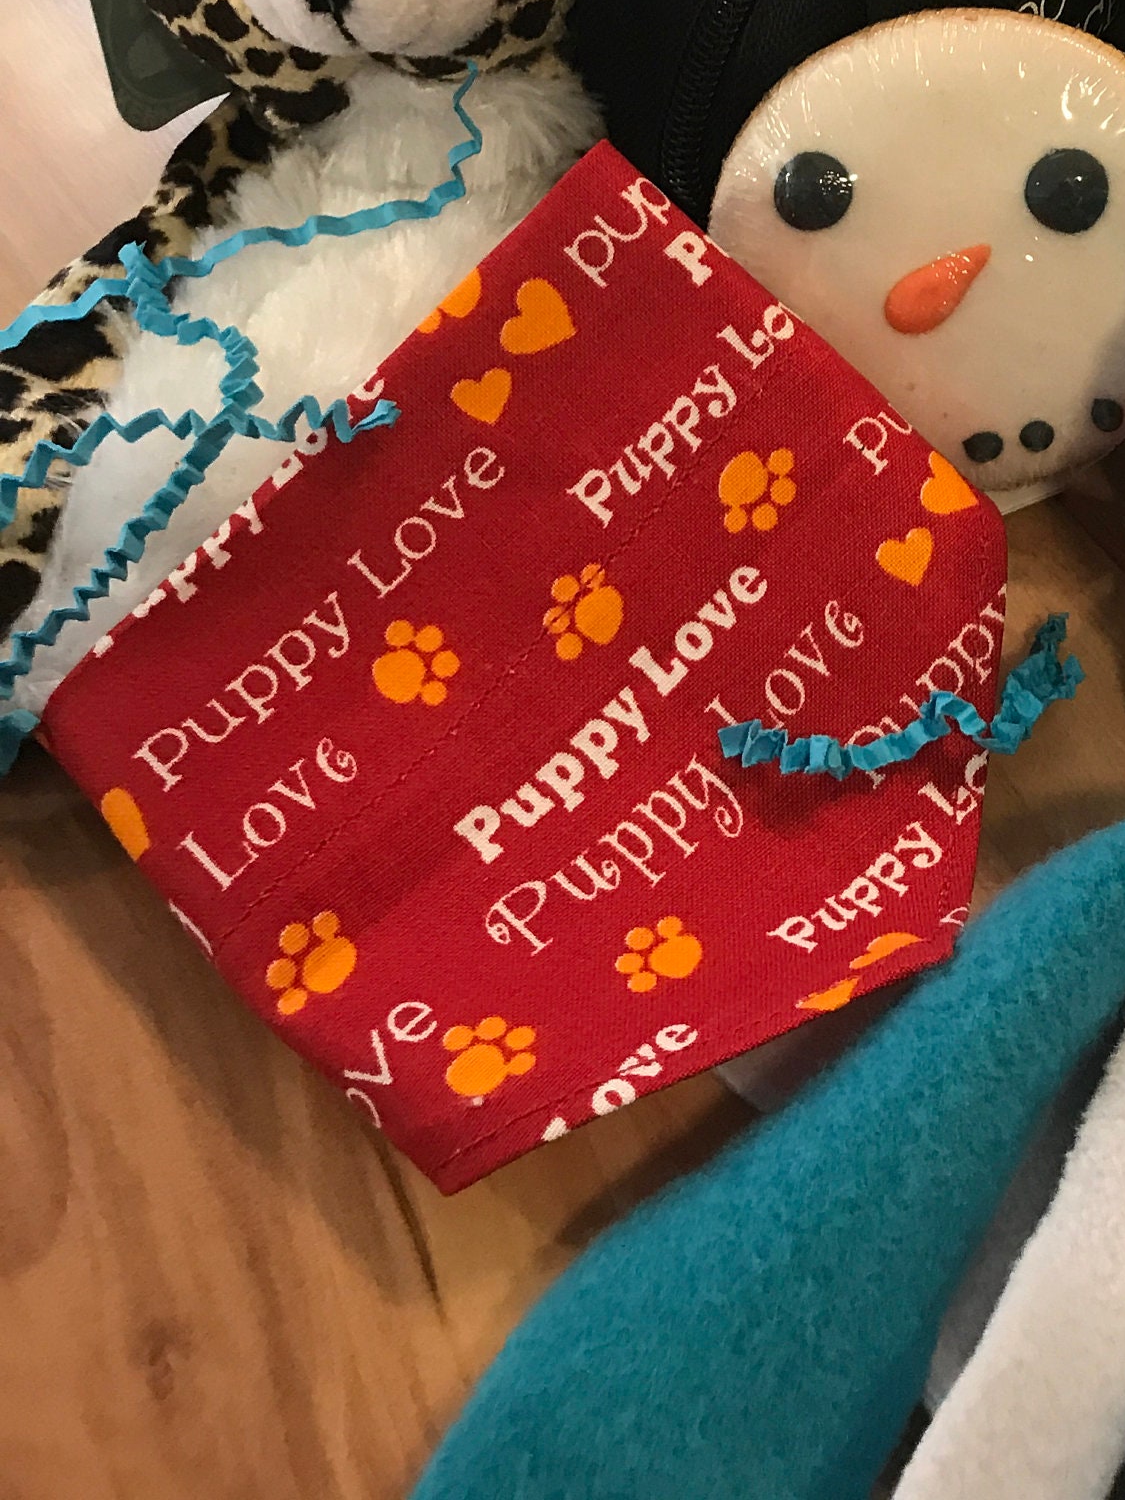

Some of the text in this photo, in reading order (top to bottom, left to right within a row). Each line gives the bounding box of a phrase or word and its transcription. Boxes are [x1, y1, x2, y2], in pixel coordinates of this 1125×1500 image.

[567, 365, 737, 528] Puppy
[716, 302, 805, 369] Lo
[132, 446, 507, 792] Puppy Love
[453, 565, 769, 865] Puppy Love
[177, 736, 358, 892] Love
[485, 752, 745, 957] Puppy
[766, 821, 943, 953] Puppy
